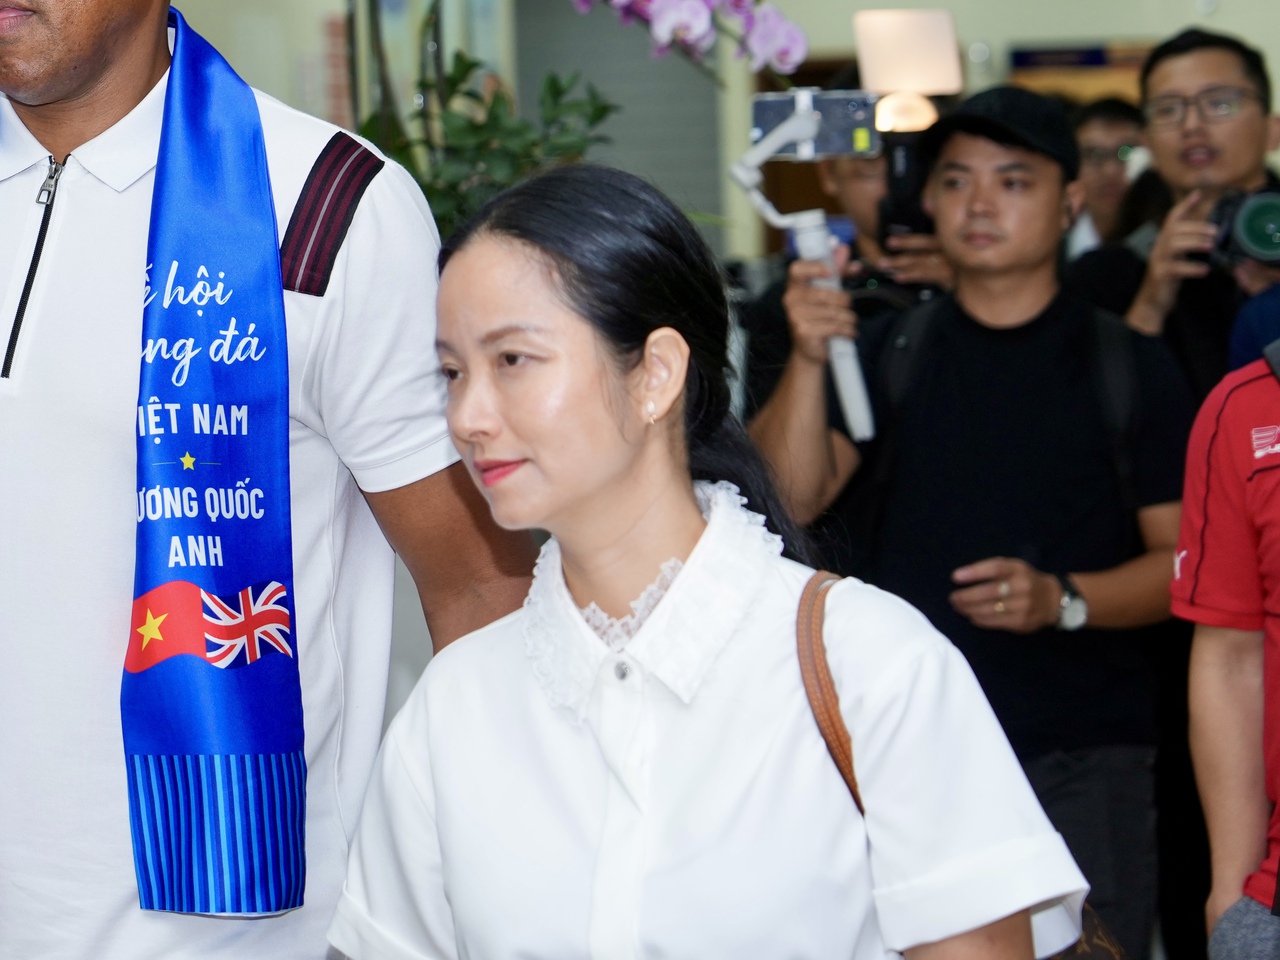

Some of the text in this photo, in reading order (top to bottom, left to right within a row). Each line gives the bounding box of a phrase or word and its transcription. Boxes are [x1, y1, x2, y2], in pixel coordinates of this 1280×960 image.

[162, 260, 233, 316] hội
[209, 317, 267, 365] đá
[192, 403, 248, 436] NAM
[204, 477, 265, 522] QUỐC
[168, 535, 224, 568] ANH
